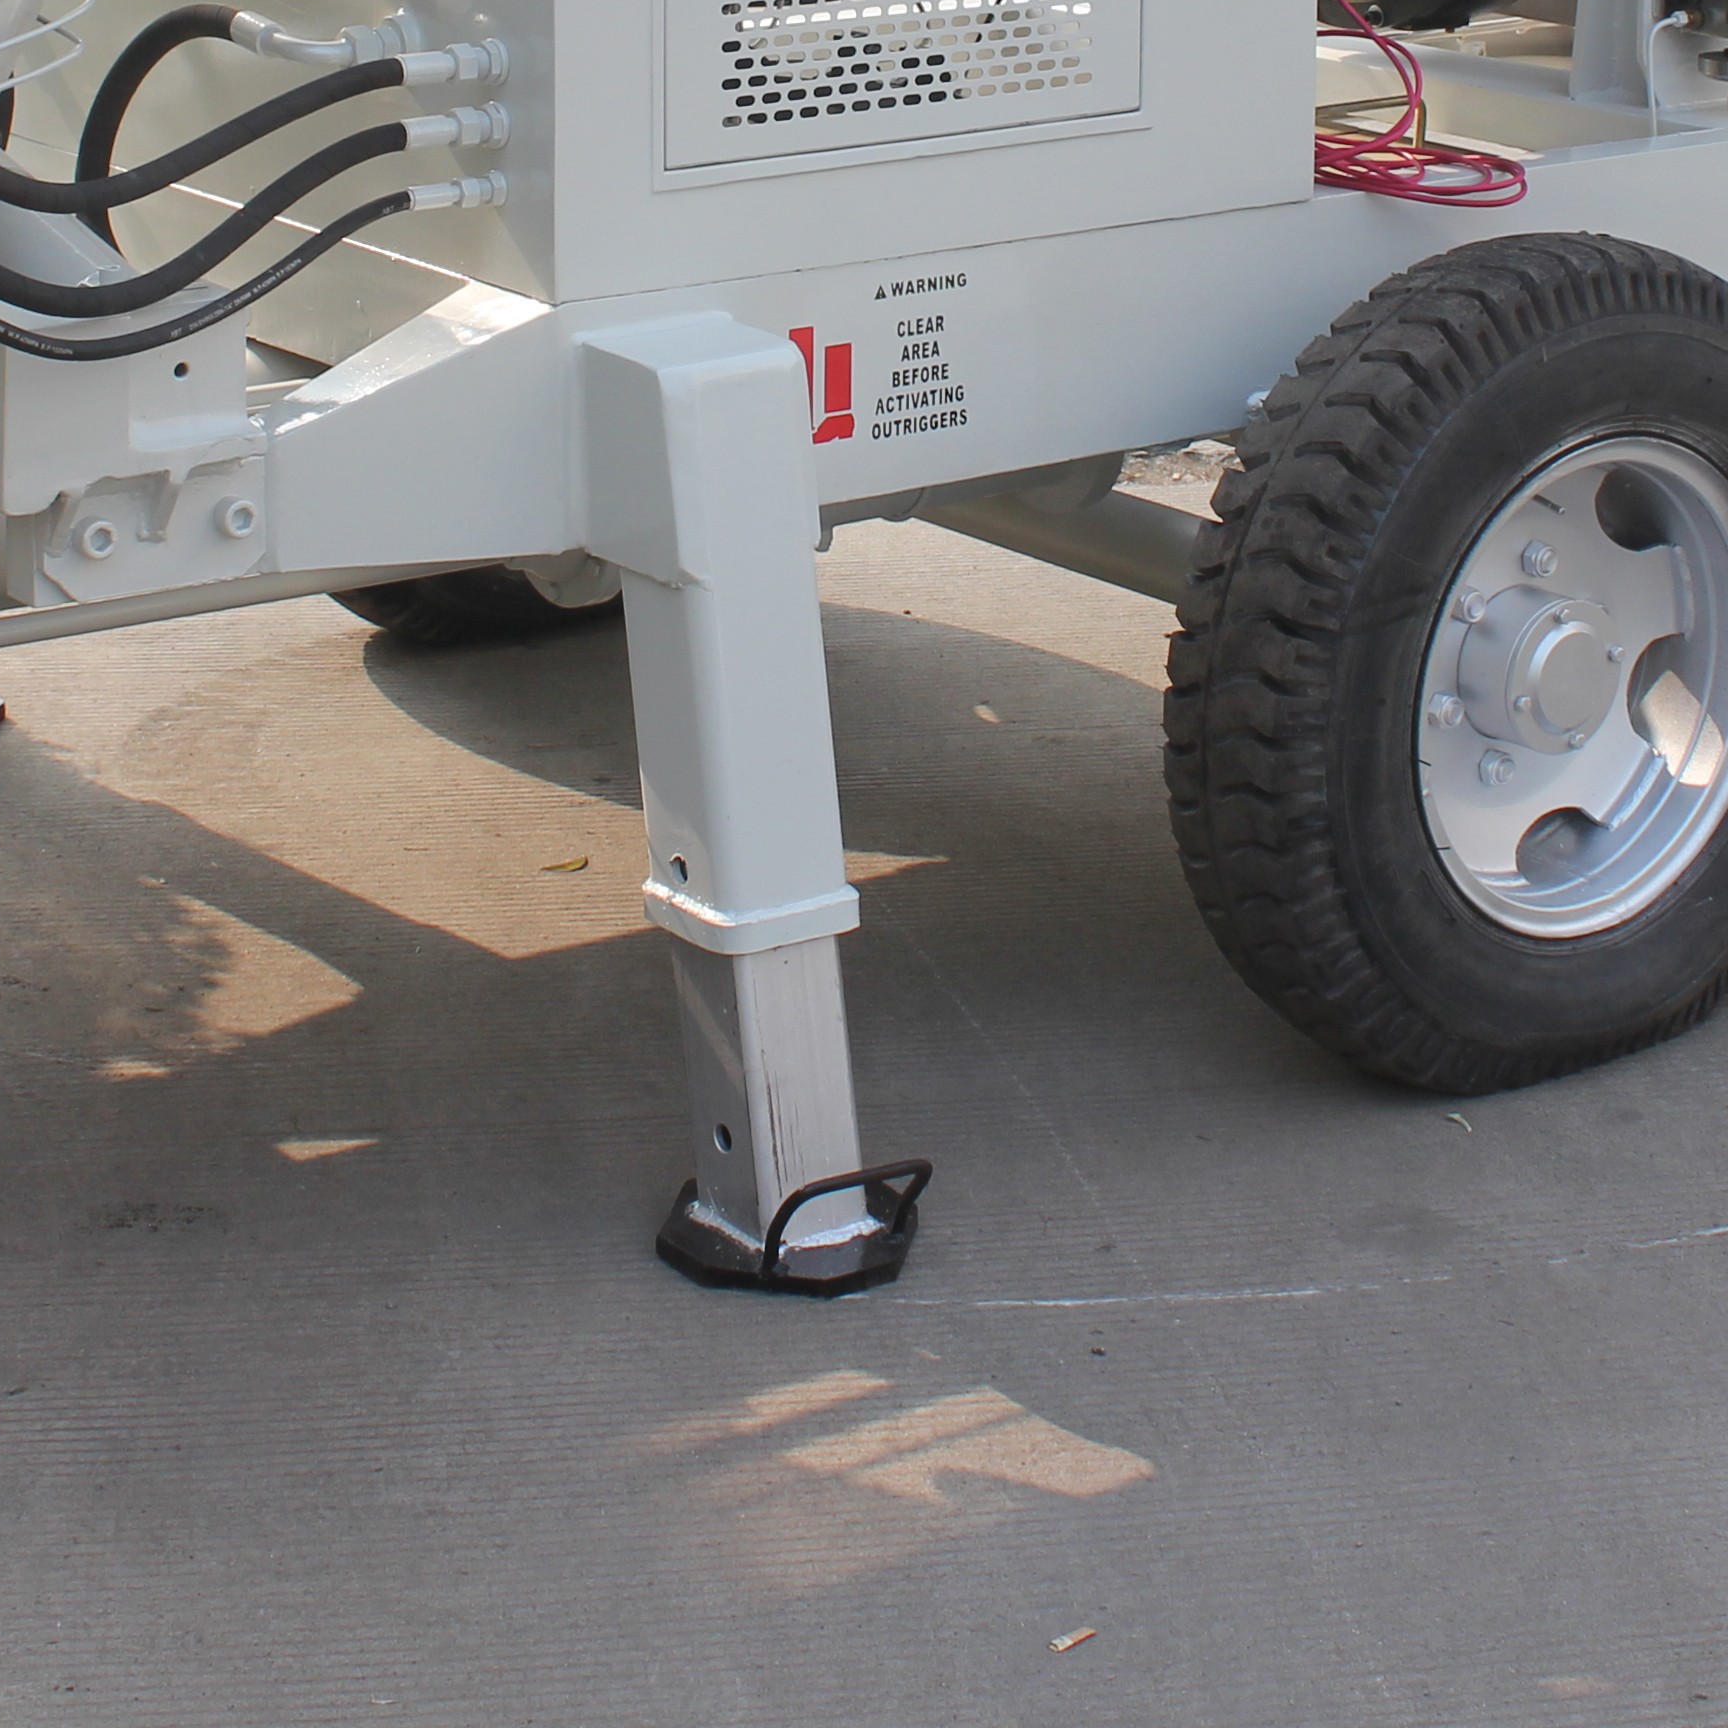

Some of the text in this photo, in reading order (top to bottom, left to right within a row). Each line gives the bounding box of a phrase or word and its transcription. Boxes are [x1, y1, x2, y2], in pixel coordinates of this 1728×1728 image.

[890, 273, 968, 298] WARNING
[897, 315, 945, 338] CLEAR
[901, 340, 940, 362] AREA
[892, 363, 949, 388] BEFORE
[875, 385, 965, 416] ACTIVATING
[872, 409, 968, 440] OUTRIGGERS
